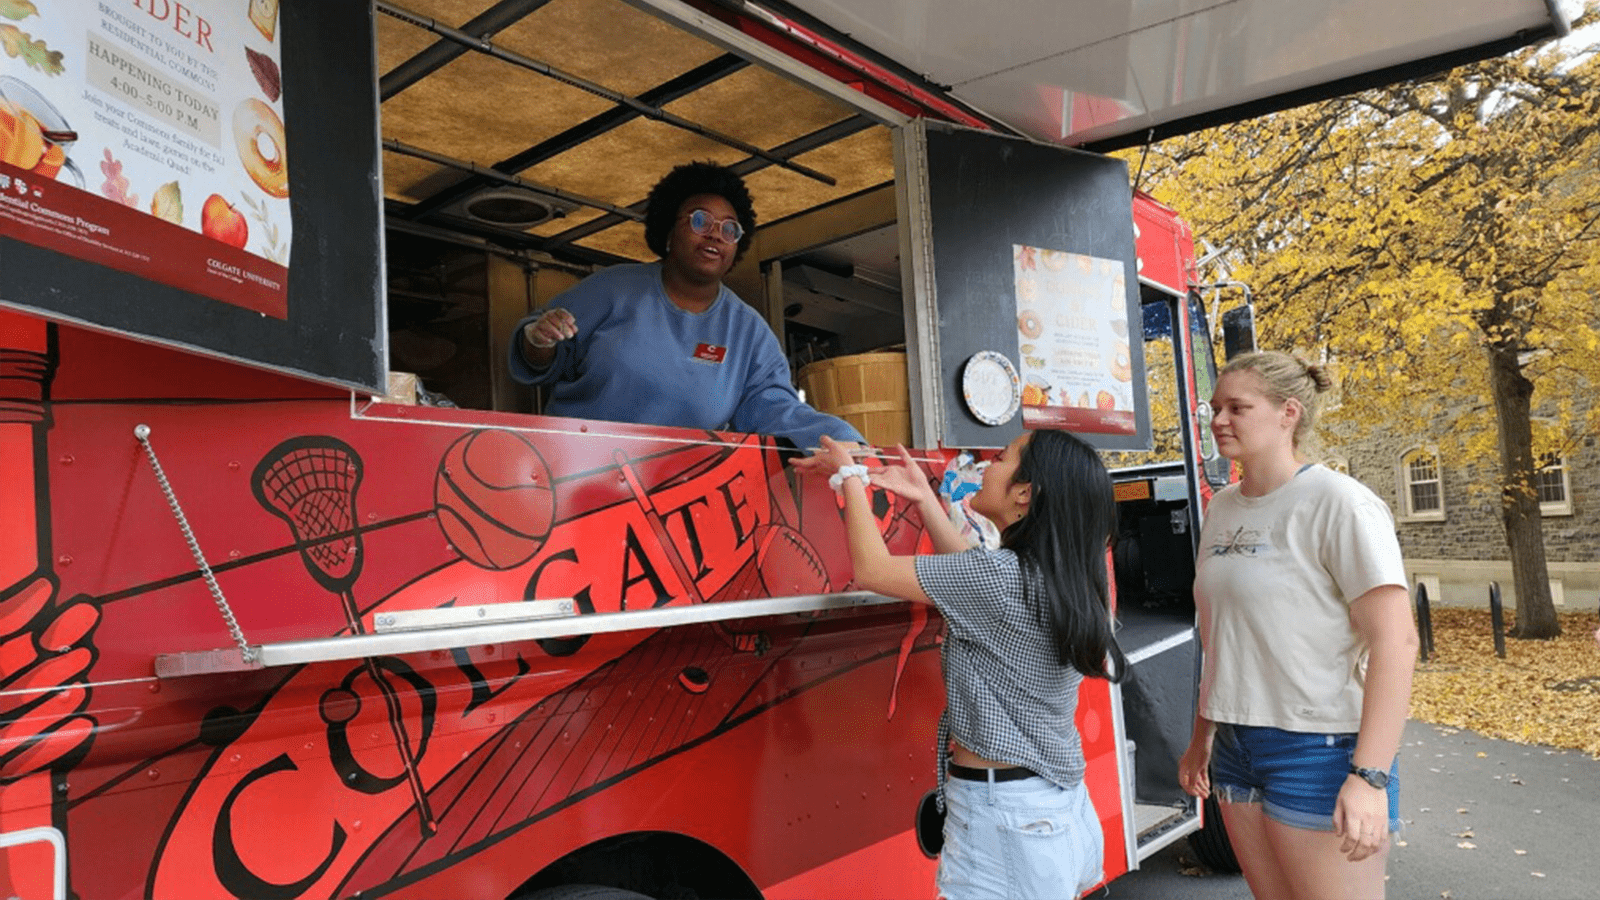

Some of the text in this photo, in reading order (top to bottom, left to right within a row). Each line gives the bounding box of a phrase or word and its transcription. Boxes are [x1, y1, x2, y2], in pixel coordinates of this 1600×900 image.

[98, 1, 147, 38] BROUGHT
[149, 32, 163, 47] TO
[165, 42, 185, 60] YOU
[133, 0, 213, 53] DER
[89, 40, 219, 121] HAPPENING TODAY
[101, 18, 216, 92] RESIDENTIAL COMMONS
[127, 112, 170, 140] Commons
[175, 108, 202, 133] P.M.
[30, 202, 75, 224] Commons
[75, 215, 110, 237] Program
[206, 258, 280, 291] COLGATE UNIVERSITY
[212, 470, 760, 898] COLGATE
